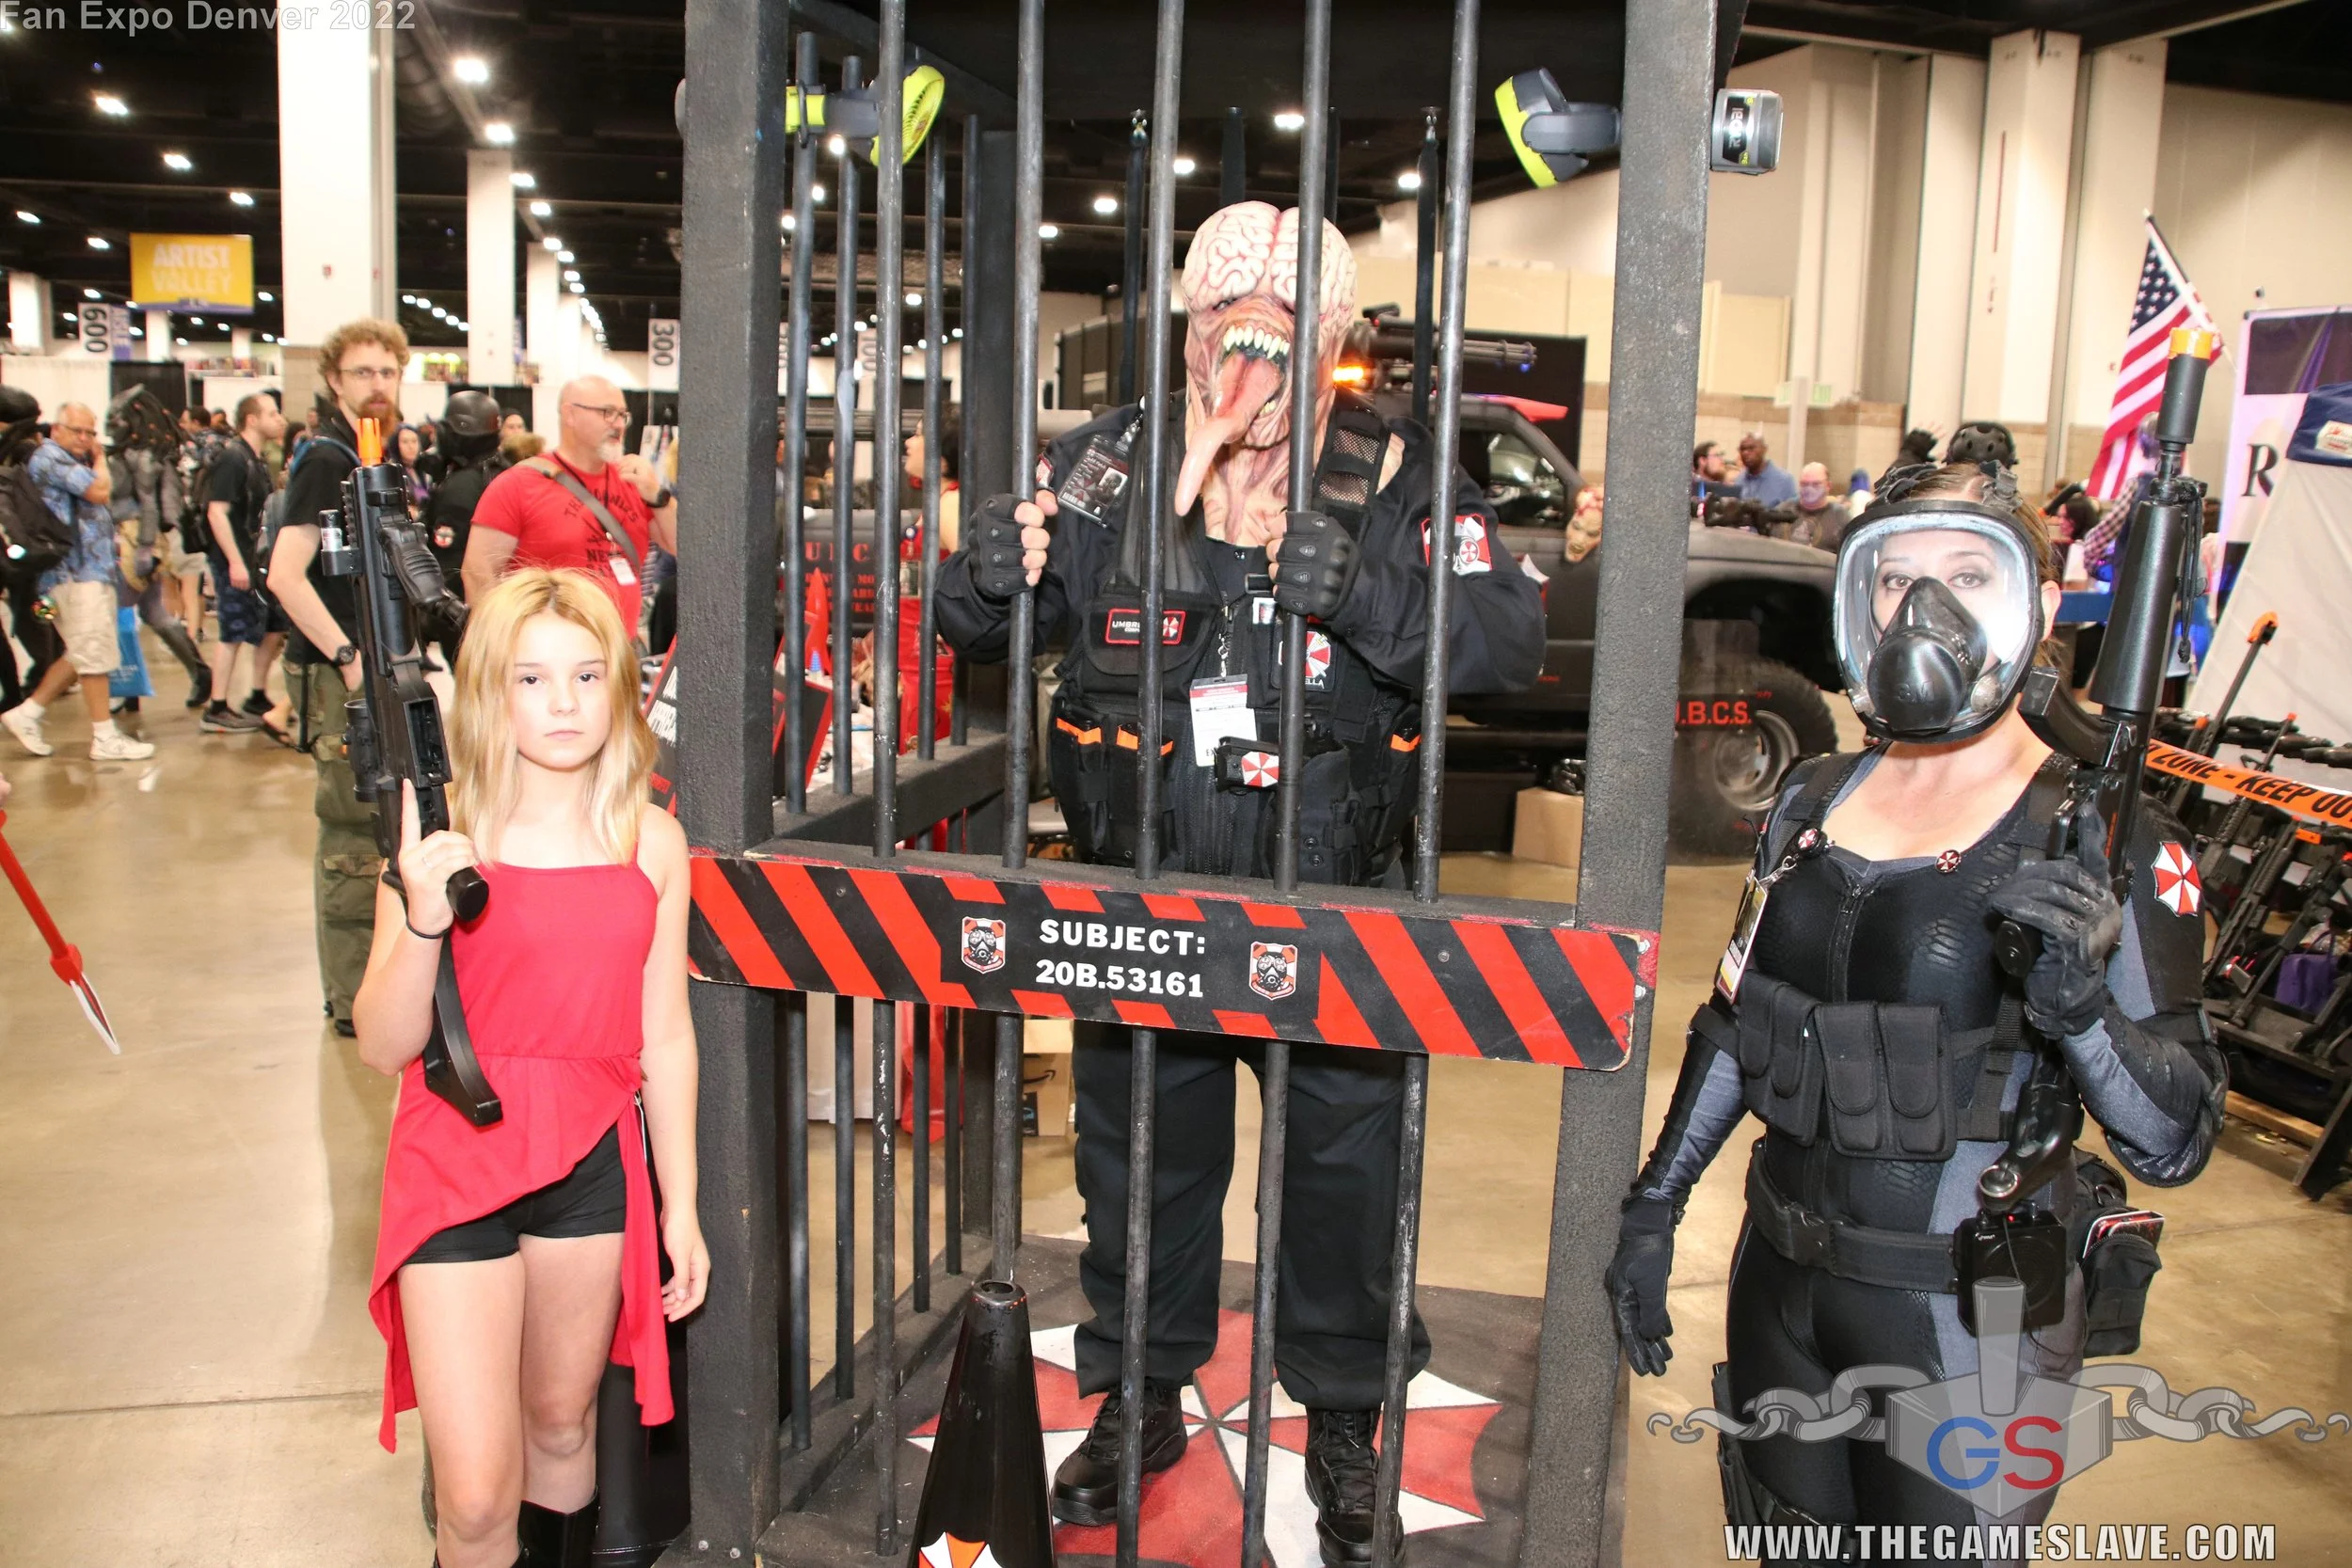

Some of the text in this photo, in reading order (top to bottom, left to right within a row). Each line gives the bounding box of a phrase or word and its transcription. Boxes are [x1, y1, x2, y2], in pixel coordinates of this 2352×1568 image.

[152, 243, 231, 268] ARTIST
[151, 269, 232, 294] VALLEY
[84, 307, 109, 354] 600
[652, 323, 675, 367] 300
[2152, 751, 2220, 780] ZONE
[2235, 774, 2318, 804] KEEP
[2311, 793, 2352, 823] OU
[1039, 918, 1206, 956] SUBJECT:
[1035, 958, 1204, 998] 20B.53161
